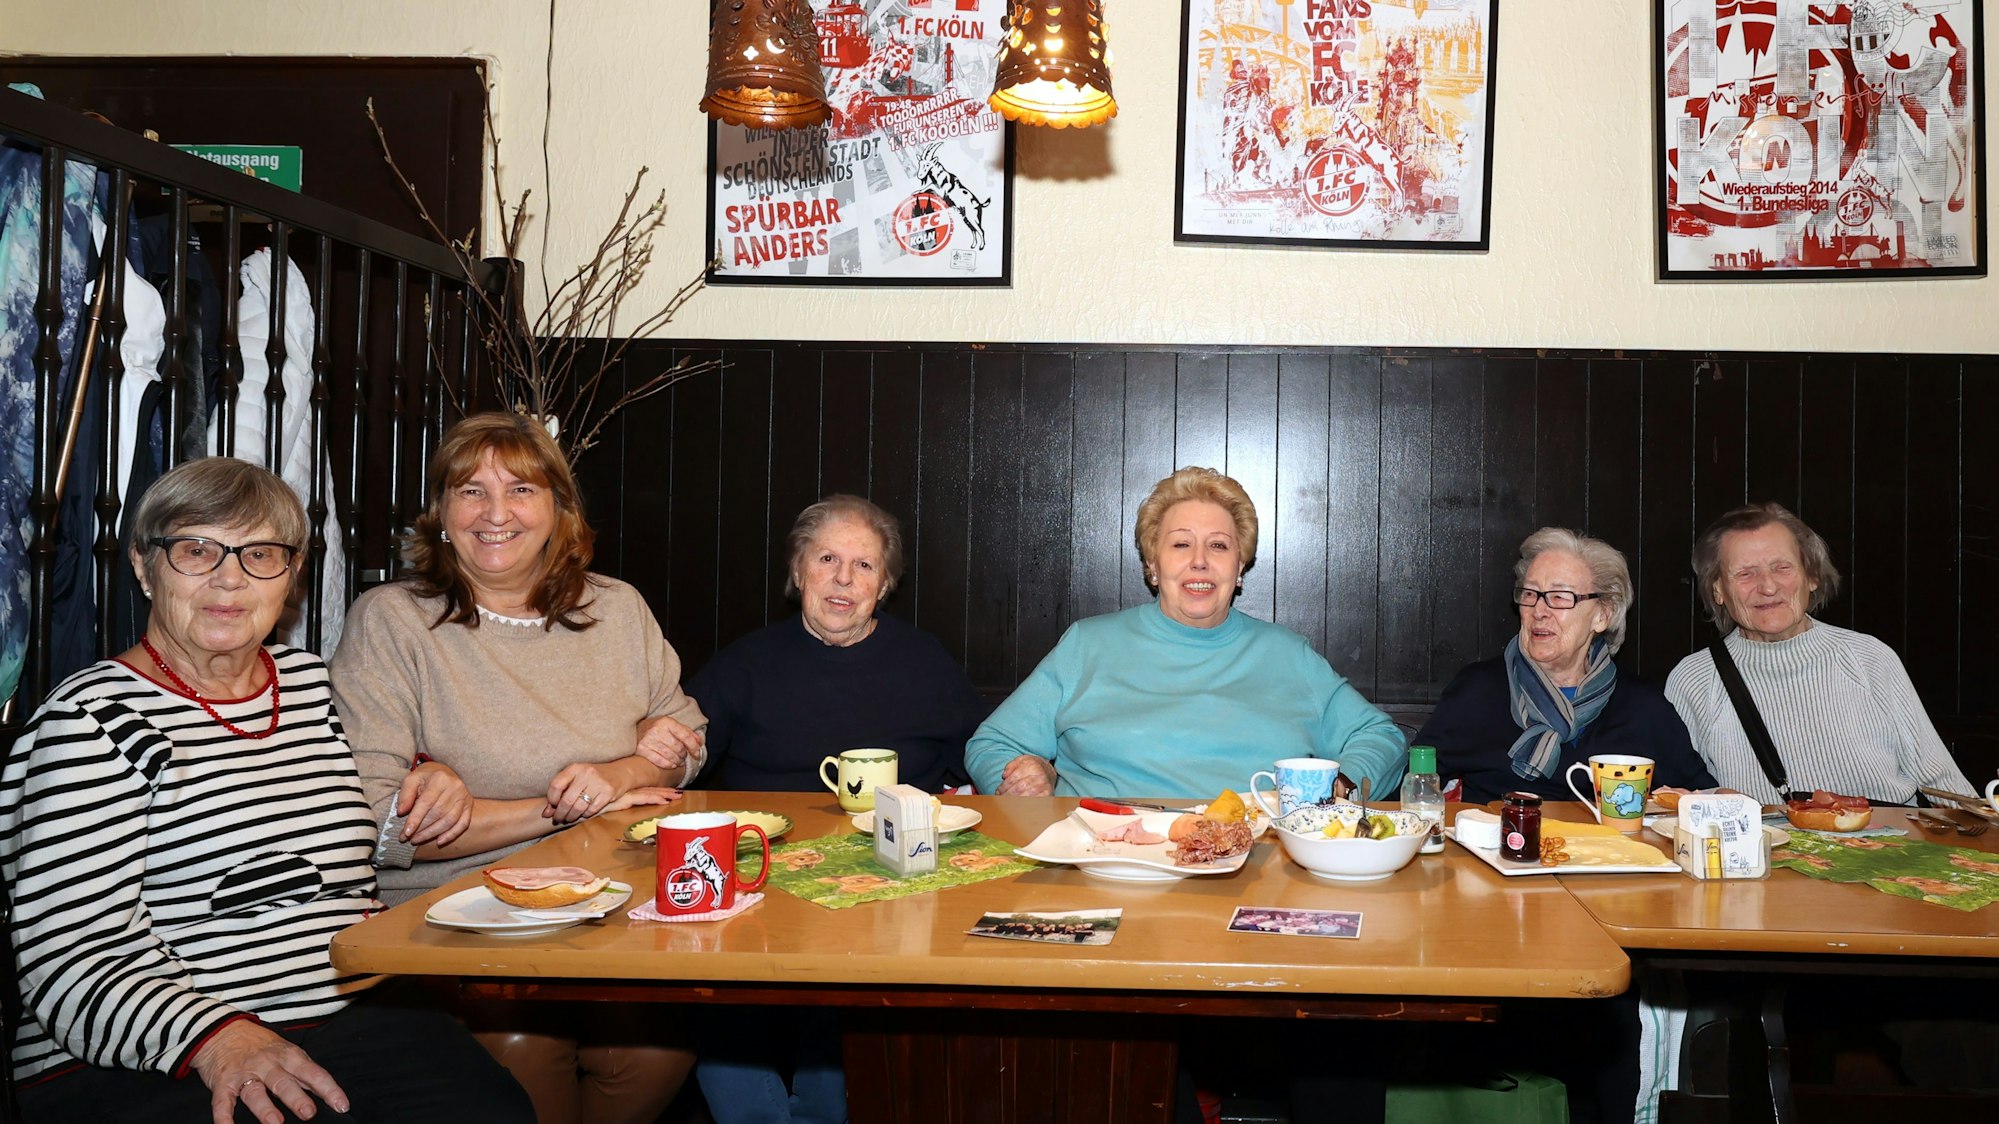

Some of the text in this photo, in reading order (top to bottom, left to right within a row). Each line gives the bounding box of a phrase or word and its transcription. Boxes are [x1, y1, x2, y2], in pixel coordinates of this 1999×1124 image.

[898, 14, 984, 40] 1. FC KÖLN
[1303, 20, 1356, 41] VOM
[820, 38, 838, 57] 11
[1313, 41, 1357, 81] FC
[885, 98, 912, 112] 19:48
[828, 137, 881, 167] STADT
[748, 163, 854, 201] DEUTSCHLANDS
[1722, 180, 1839, 197] Wiederaufstieg 2014
[725, 197, 842, 234] SPÜRBAR
[1737, 196, 1829, 215] 1. Bundesliga
[734, 228, 830, 267] ANDERS
[908, 841, 933, 858] Sion
